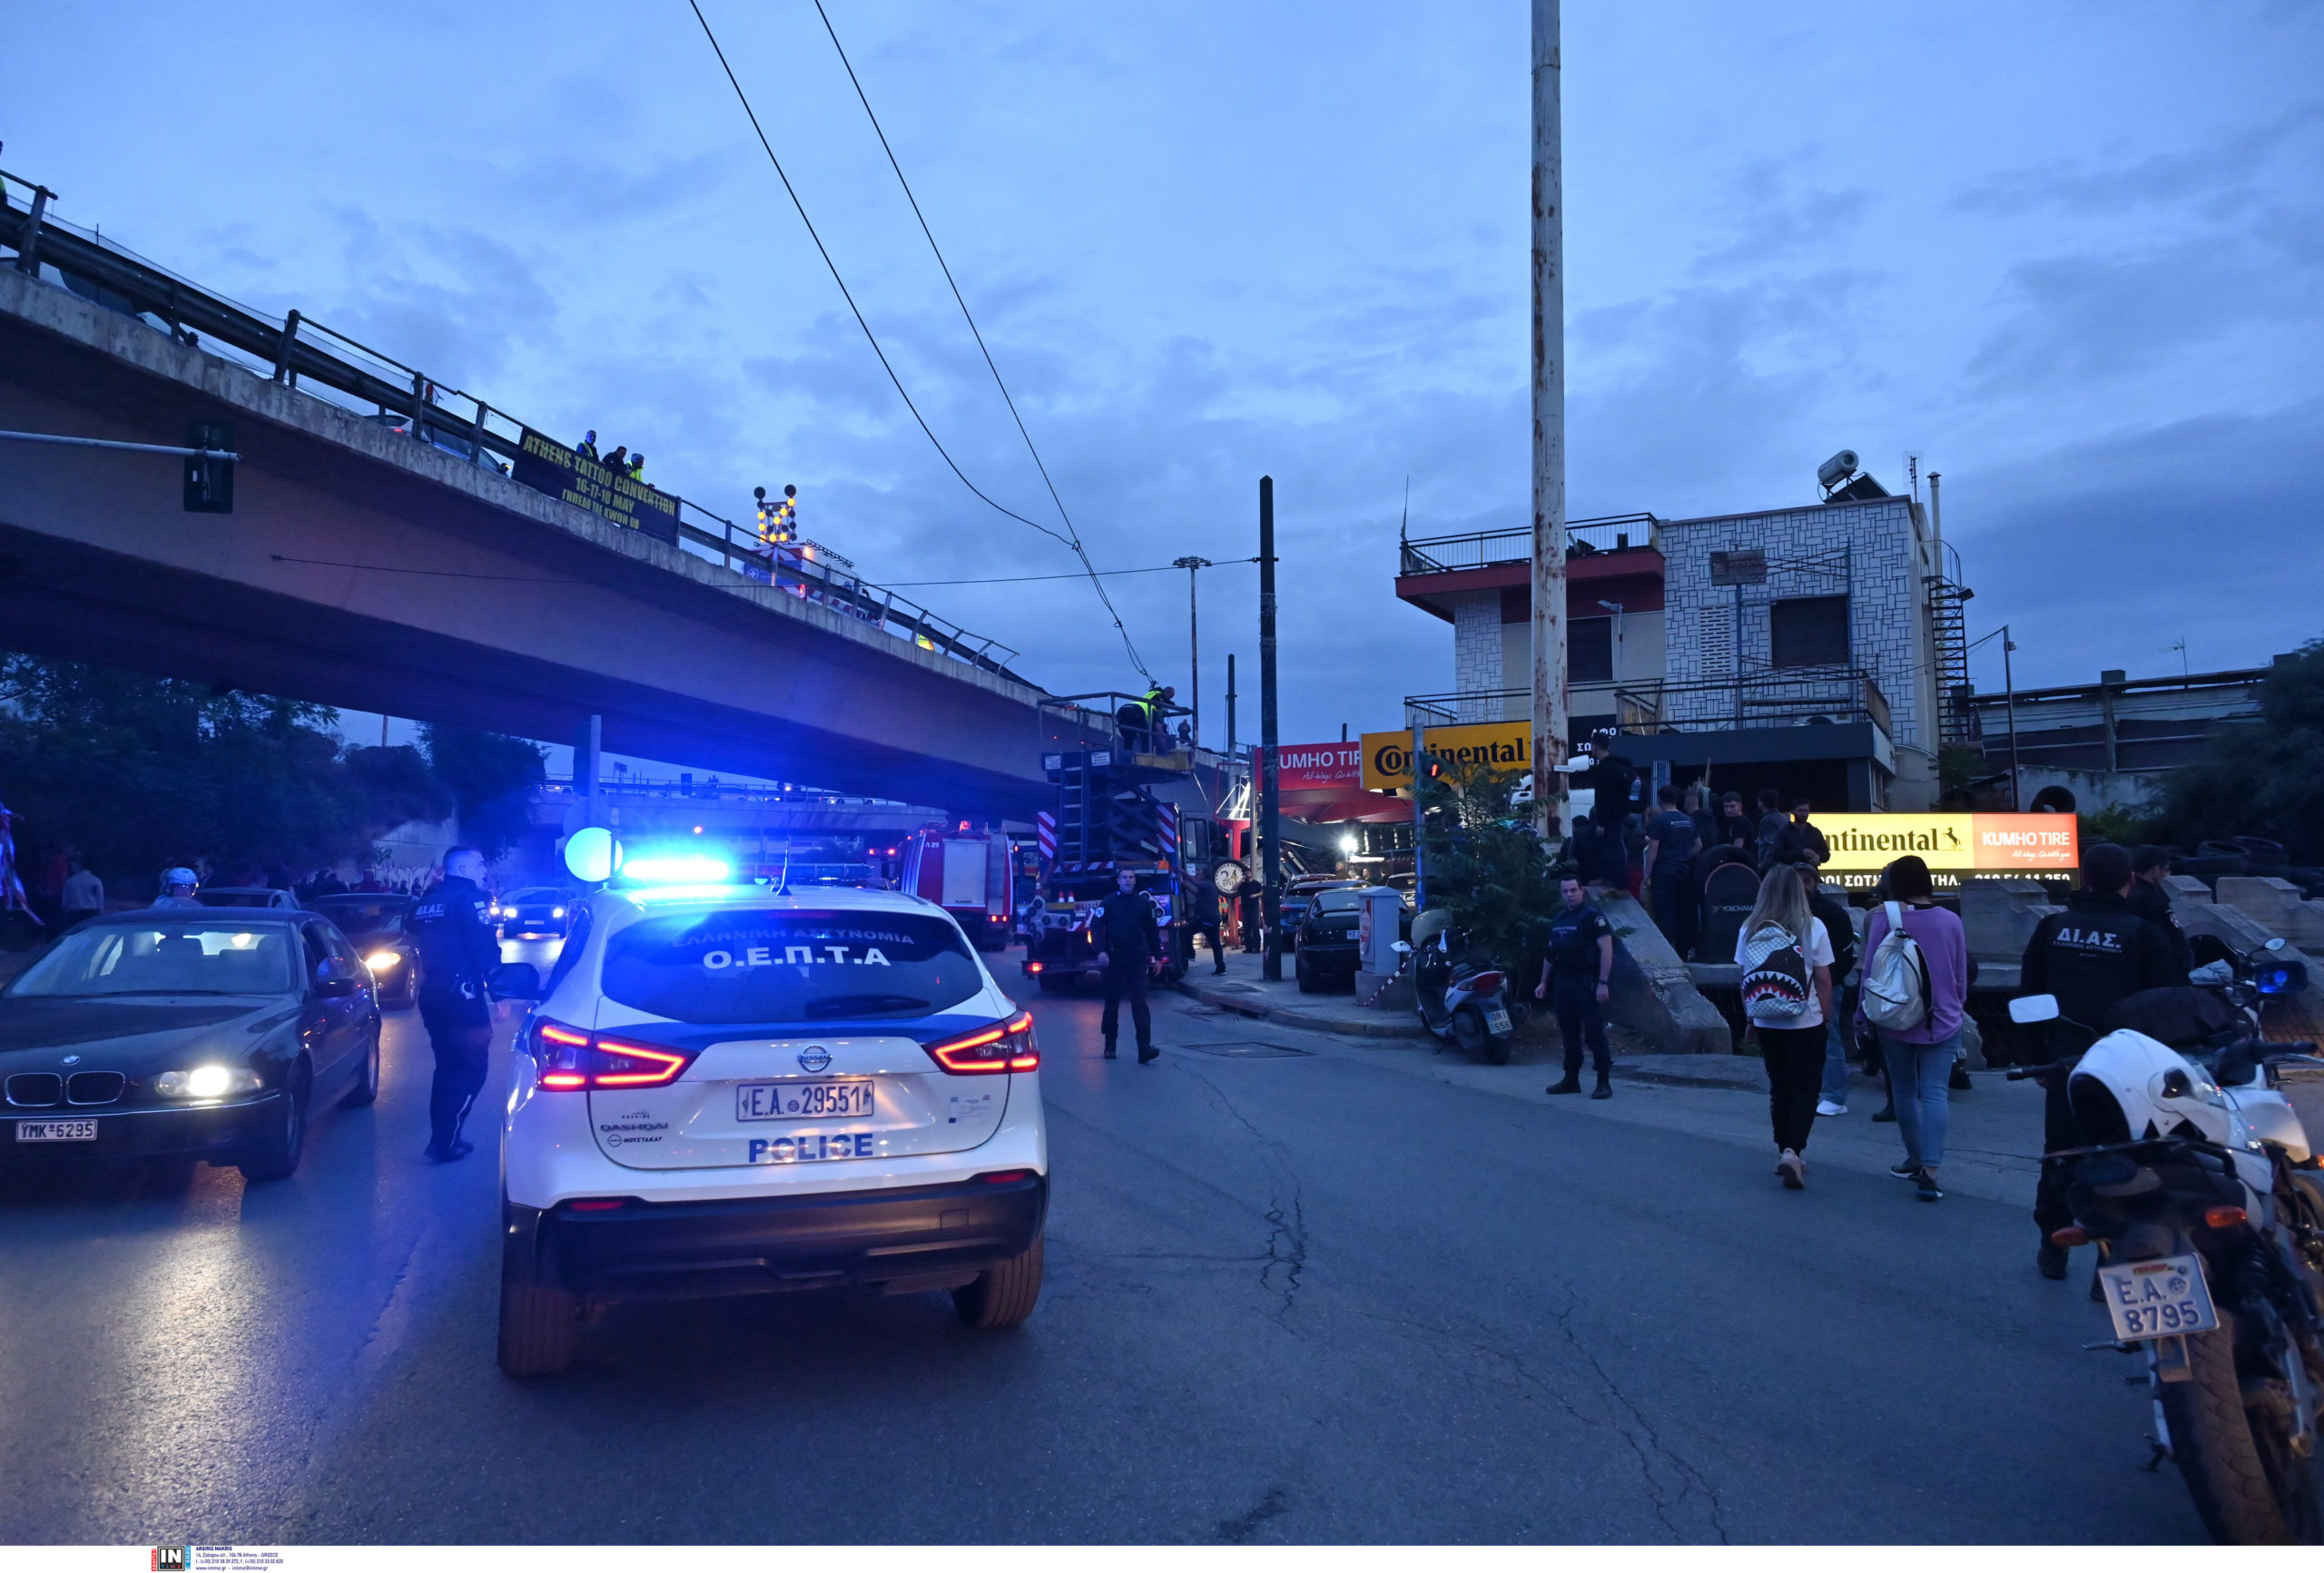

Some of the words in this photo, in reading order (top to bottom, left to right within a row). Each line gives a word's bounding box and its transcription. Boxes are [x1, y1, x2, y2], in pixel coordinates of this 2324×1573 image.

[522, 435, 572, 469] ATHENS
[575, 456, 613, 487] TATTOO
[614, 477, 675, 516] CONVENTION
[613, 494, 635, 514] MAY
[604, 507, 628, 526] KWON
[629, 516, 640, 530] DO
[1278, 752, 1334, 770] UMHO
[1825, 828, 1939, 850] ntinental
[1983, 831, 2037, 846] KUMHO
[2038, 831, 2071, 846] TIRE
[673, 929, 787, 948] ΕΛΛΗΝΙΚΗ
[793, 928, 916, 945] ΑΣΤΥΝΟΜΙΑ
[2056, 927, 2122, 949] ΔΙ.ΑΣ.
[802, 1086, 860, 1115] 29551
[600, 1123, 669, 1132] QASHQAI
[749, 1134, 873, 1164] POLICE
[2125, 1301, 2200, 1332] 8795
